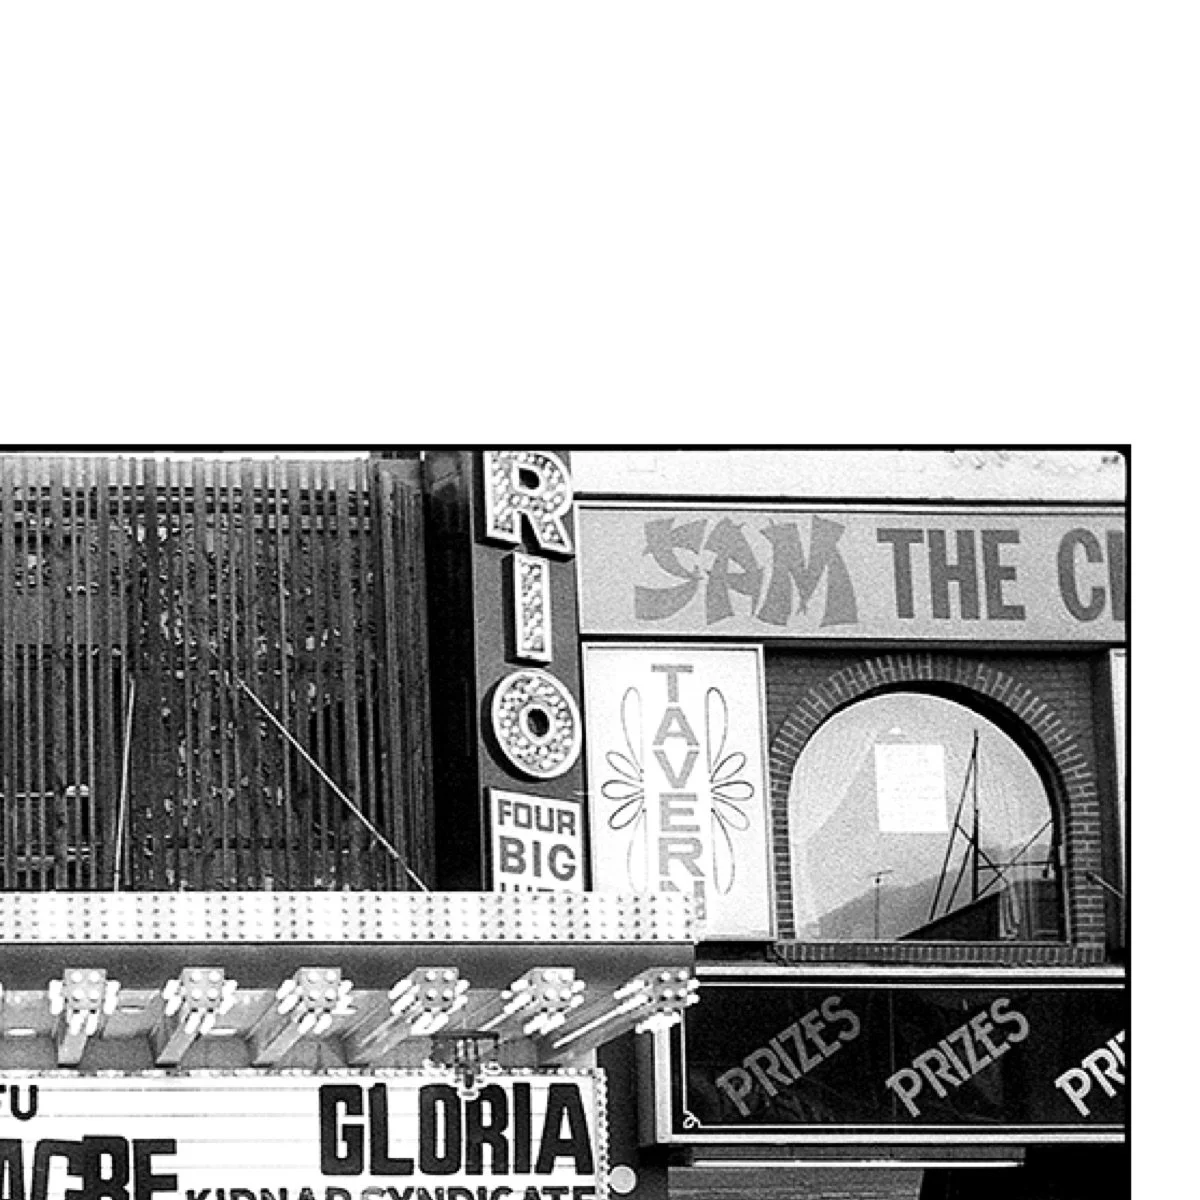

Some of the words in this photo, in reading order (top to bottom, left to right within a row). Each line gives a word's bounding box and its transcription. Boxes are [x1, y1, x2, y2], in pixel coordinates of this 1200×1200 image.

[483, 450, 582, 780] RIO
[634, 515, 858, 628] SAM
[877, 528, 1026, 620] THE
[499, 800, 576, 835] FOUR
[500, 836, 577, 881] BIG
[716, 996, 860, 1115] PRIZES
[885, 997, 1030, 1118] PRIZES
[318, 1082, 596, 1176] GLORIA
